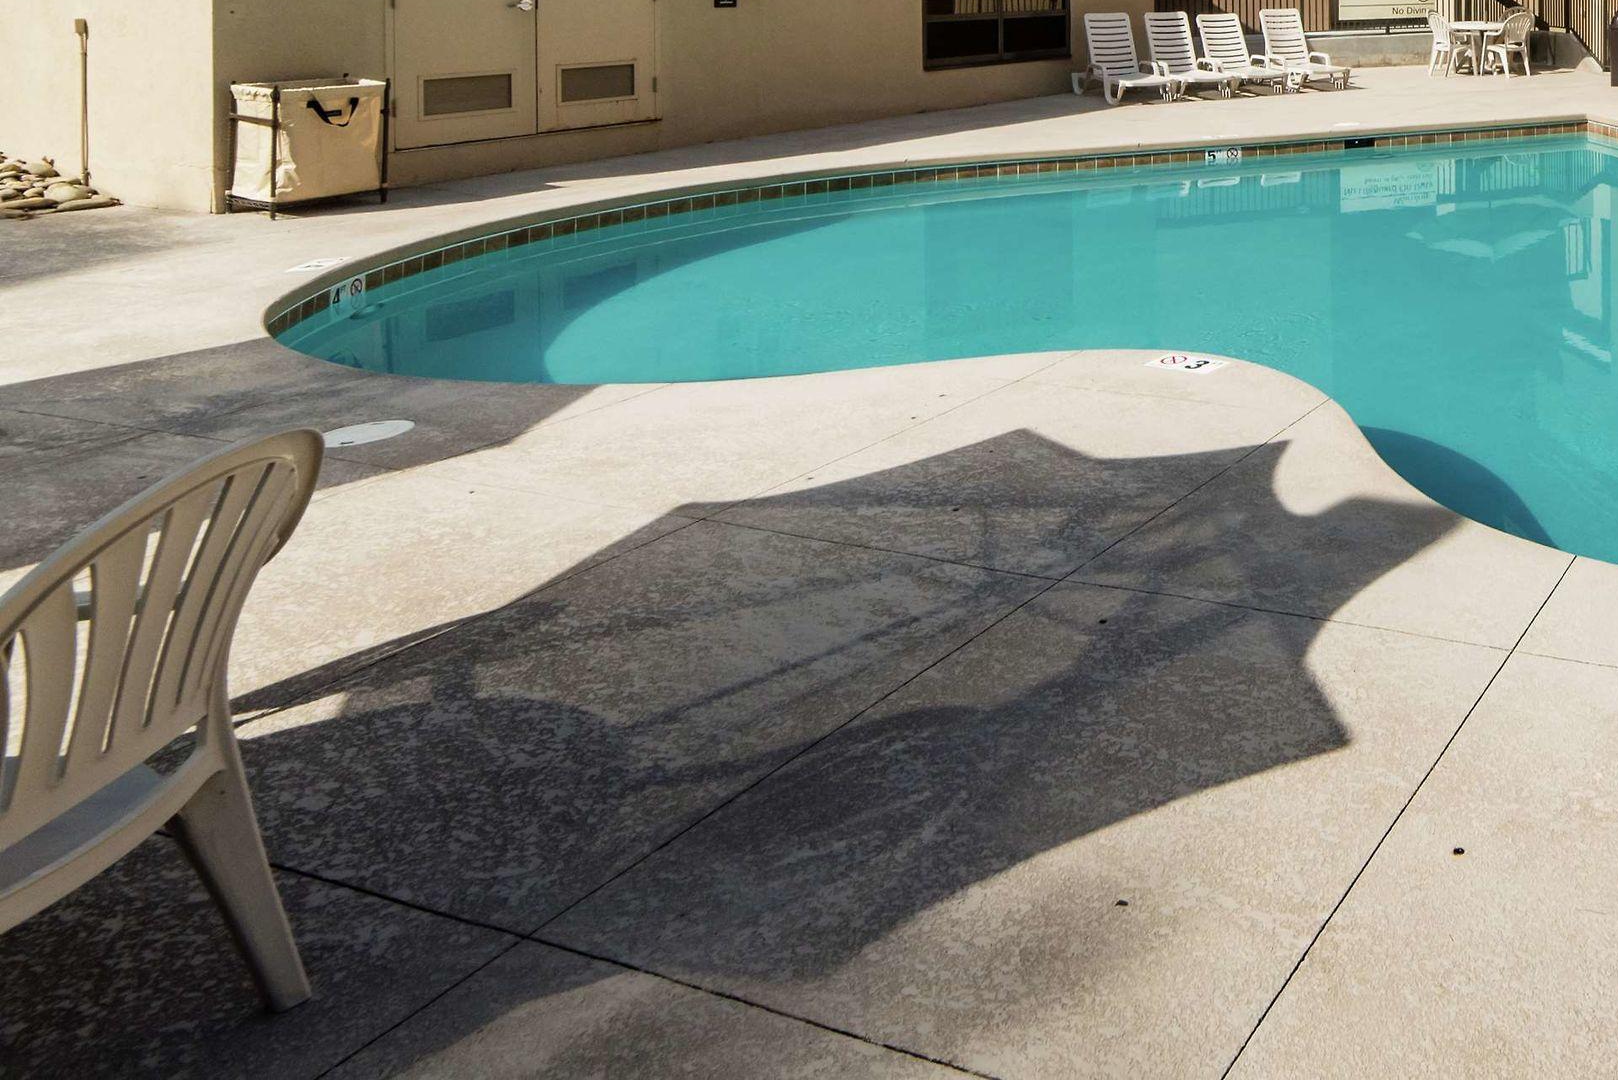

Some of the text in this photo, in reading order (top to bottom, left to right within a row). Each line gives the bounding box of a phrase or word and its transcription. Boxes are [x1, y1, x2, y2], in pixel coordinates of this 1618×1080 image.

[1392, 6, 1426, 15] No Divin
[1207, 150, 1216, 160] 5
[332, 287, 340, 304] 4
[1184, 360, 1210, 369] 3
